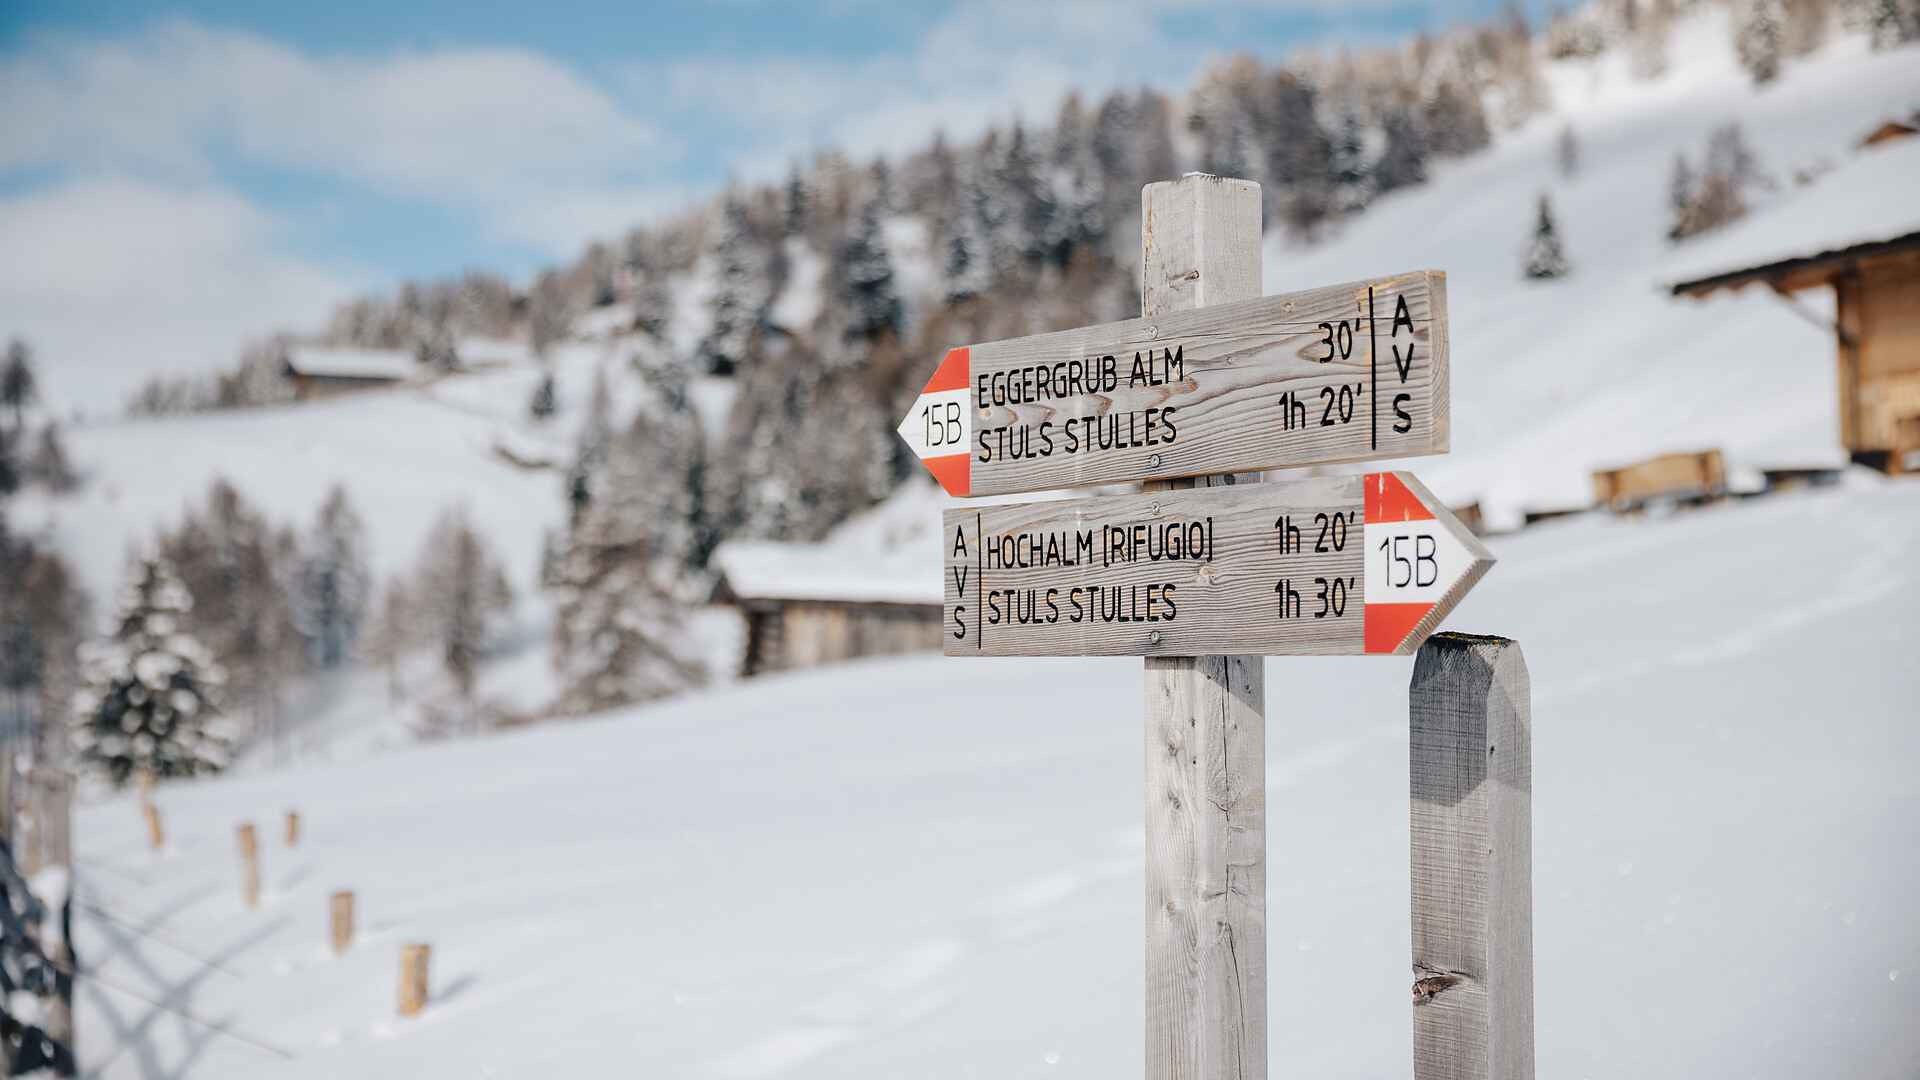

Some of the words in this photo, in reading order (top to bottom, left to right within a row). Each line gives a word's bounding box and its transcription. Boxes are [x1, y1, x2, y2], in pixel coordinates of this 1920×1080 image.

[978, 355, 1117, 409] EGGERGRUB
[1130, 345, 1184, 389] ALM
[922, 402, 962, 447] 15B
[1279, 391, 1305, 430] 1h
[1320, 382, 1362, 426] 20'
[979, 422, 1053, 463] STULS
[1065, 407, 1177, 454] STULLES
[987, 529, 1093, 569] HOCHALM
[1104, 517, 1213, 567] [RIFUGIO]
[1275, 515, 1300, 555] 1h
[1314, 511, 1355, 552] 20'
[1379, 534, 1437, 587] 15B
[988, 588, 1058, 624] STULS
[1070, 583, 1177, 623] STULLES
[1275, 579, 1300, 618] 1h
[1315, 577, 1355, 618] 30'
